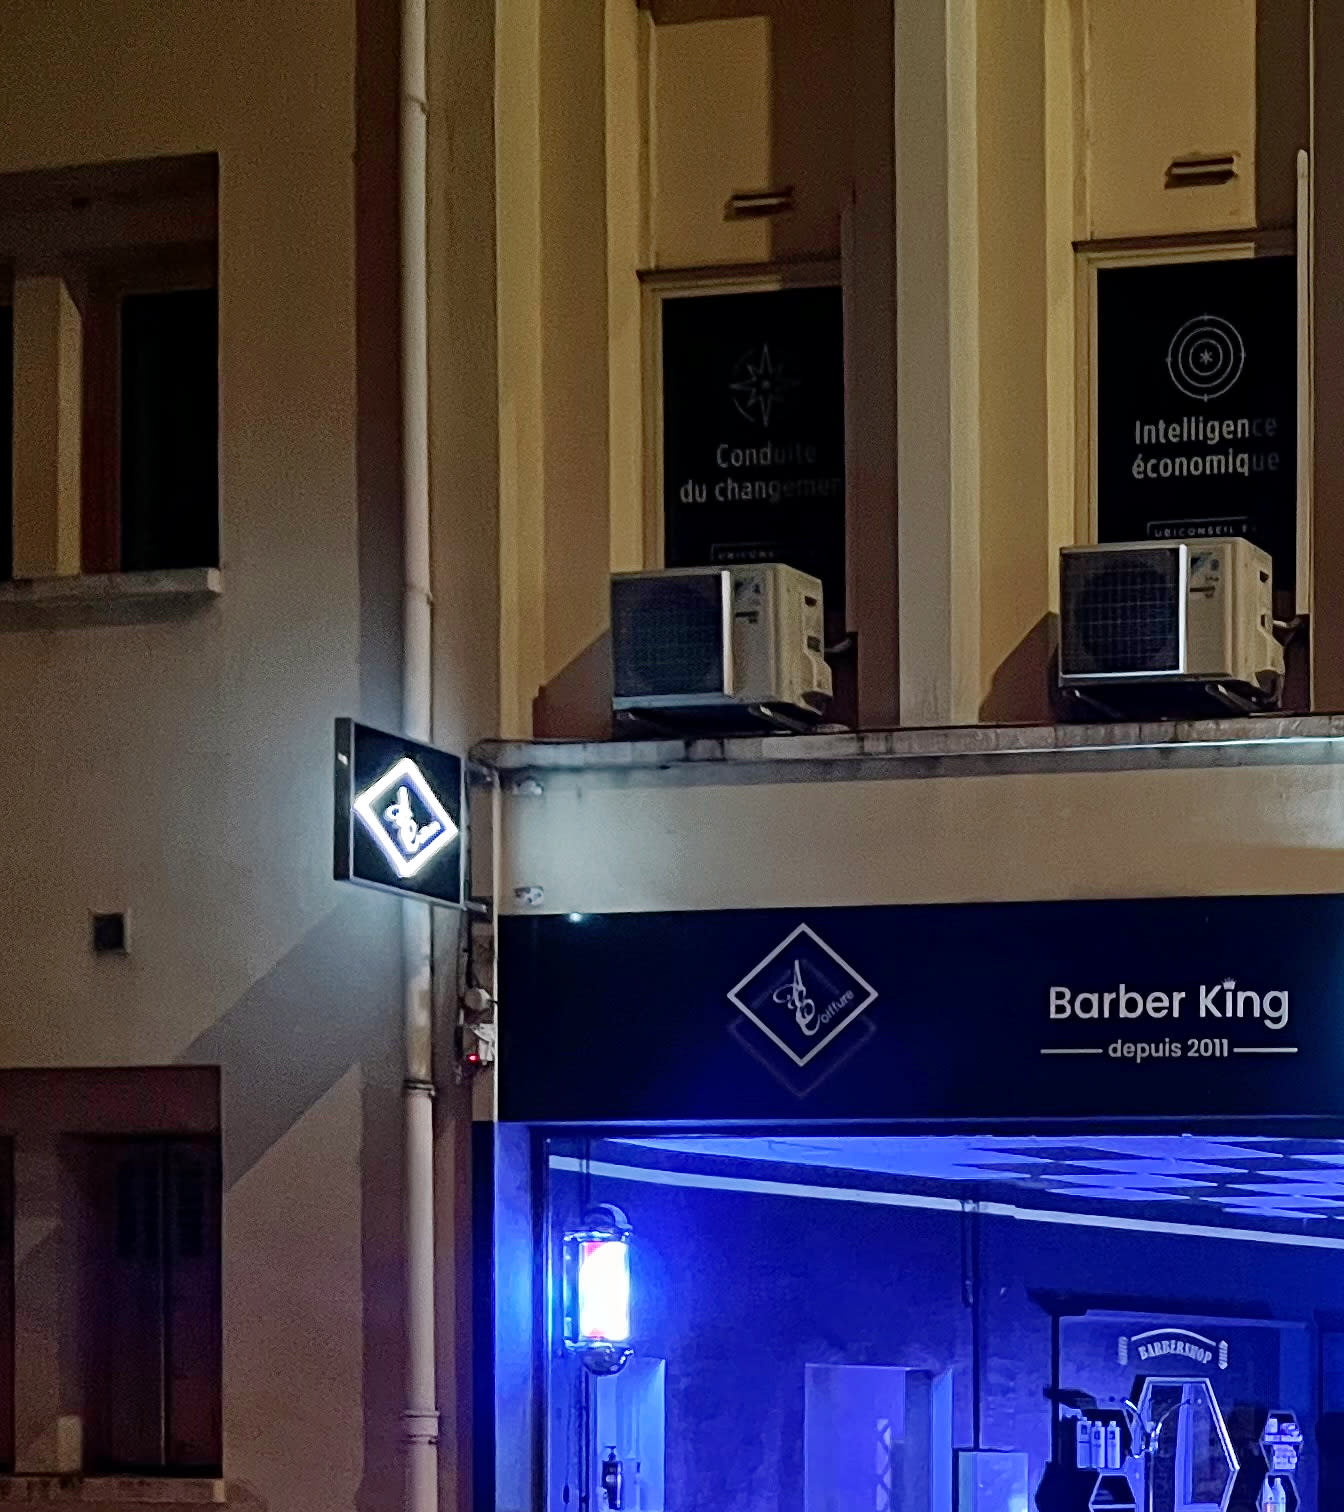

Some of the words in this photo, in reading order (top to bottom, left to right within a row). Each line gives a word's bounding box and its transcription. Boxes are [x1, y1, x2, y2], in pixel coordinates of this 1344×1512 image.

[1135, 415, 1278, 445] Intelligence
[715, 440, 817, 468] Conduite
[1131, 447, 1281, 480] économique
[679, 478, 708, 504] du
[714, 476, 843, 505] changemen
[1049, 983, 1186, 1019] Barber
[1200, 983, 1290, 1030] King
[1108, 1038, 1182, 1063] depuis
[1187, 1038, 1229, 1058] 2011
[1138, 1340, 1213, 1364] BARBERSHOP
